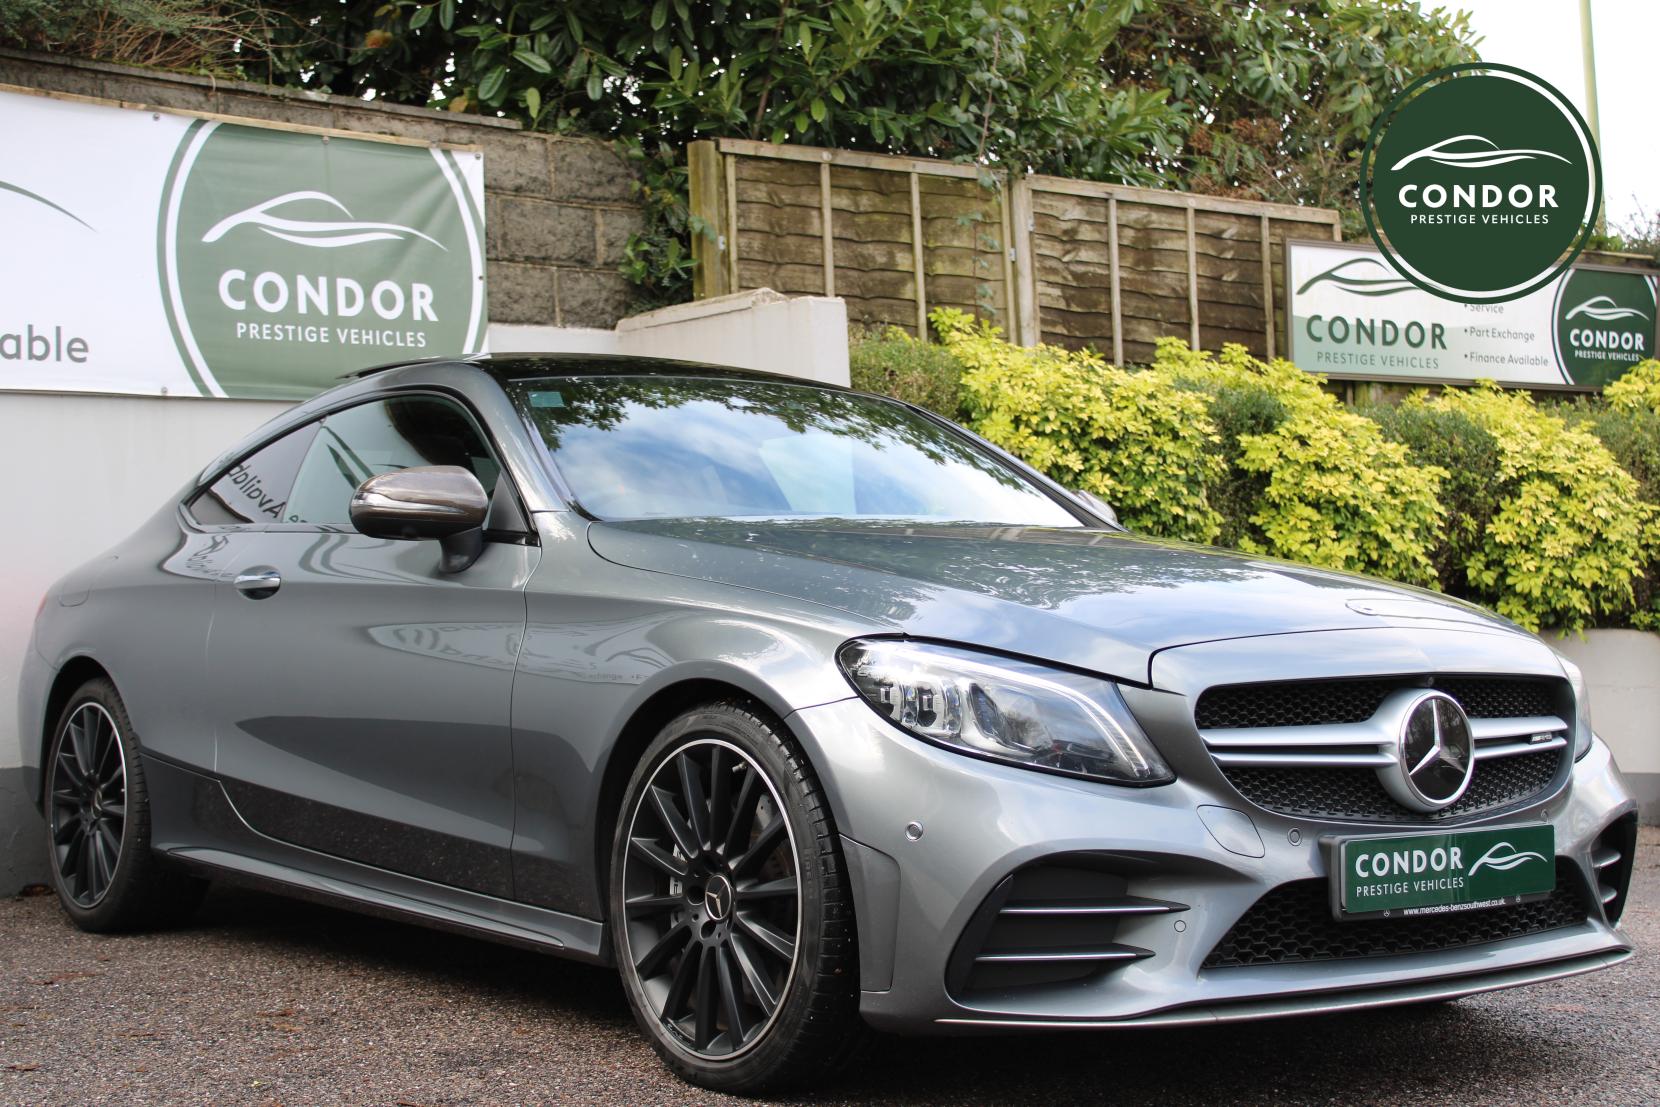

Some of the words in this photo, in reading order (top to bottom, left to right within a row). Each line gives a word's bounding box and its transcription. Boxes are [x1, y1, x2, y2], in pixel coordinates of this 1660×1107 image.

[218, 269, 439, 322] CONDOR
[1469, 304, 1504, 314] Service
[236, 322, 330, 344] PRESTIGE
[336, 329, 427, 348] VEHICLES
[1306, 314, 1447, 350] CONDOR
[1469, 326, 1490, 338] Part
[1491, 328, 1535, 343] Exchange
[1569, 328, 1645, 352] CONDOR
[0, 323, 89, 363] able
[1317, 351, 1376, 367] PRESTIGE
[1381, 354, 1439, 370] VEHICLES
[1469, 351, 1506, 364] Finance
[1507, 354, 1549, 367] Available
[1574, 349, 1606, 360] PRESTIGE
[1607, 351, 1640, 363] VEHICLES
[1355, 847, 1463, 878] CONDOR
[1356, 883, 1409, 897] PRESTIGE
[1414, 877, 1464, 892] VEHICLES
[1403, 898, 1506, 916] www.mercedes-benzsouthwest.co.uk
